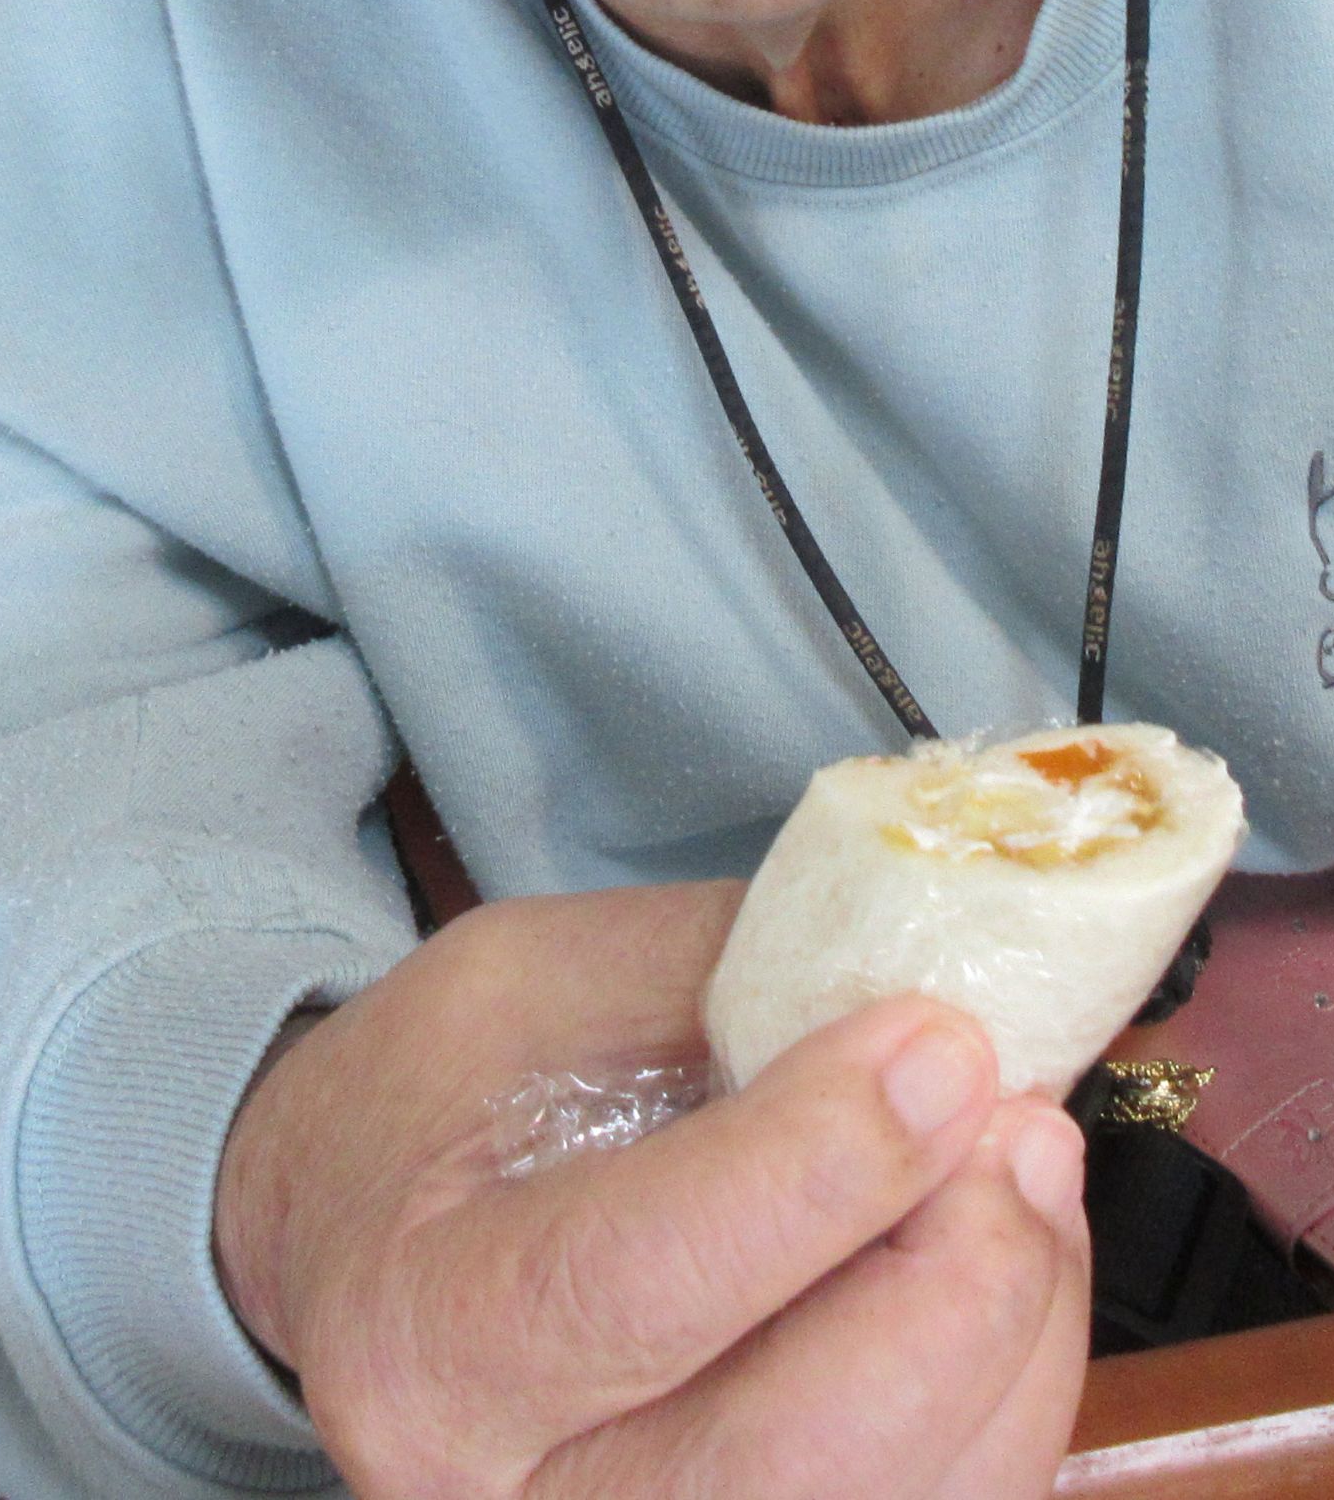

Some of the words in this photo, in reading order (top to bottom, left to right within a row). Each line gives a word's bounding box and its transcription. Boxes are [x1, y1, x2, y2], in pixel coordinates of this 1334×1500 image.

[553, 6, 614, 109] angelic
[1084, 539, 1113, 662] angelic
[843, 621, 924, 723] angelic
